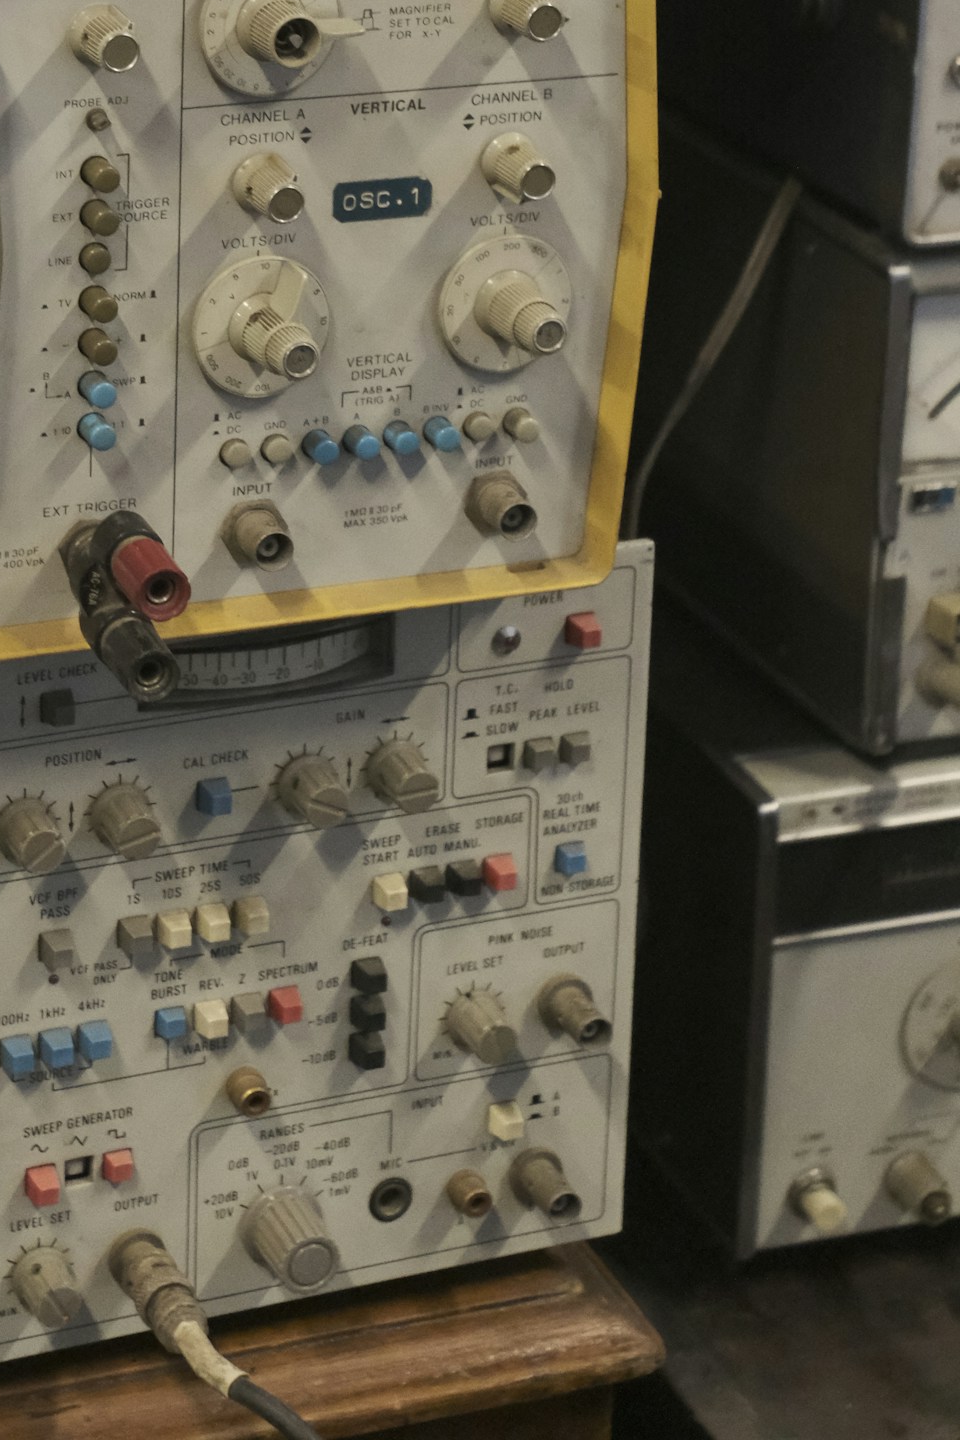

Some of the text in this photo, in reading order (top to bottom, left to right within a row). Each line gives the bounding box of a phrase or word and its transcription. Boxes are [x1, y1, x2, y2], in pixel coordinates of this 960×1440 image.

[389, 3, 452, 15] MAGNIFIER
[433, 15, 455, 26] CAL
[64, 98, 102, 109] PROBE
[471, 90, 538, 106] CHANNEL
[350, 99, 427, 115] VERTICAL
[221, 110, 289, 127] CHANNEL
[480, 112, 542, 126] POSITION
[229, 131, 295, 146] POSITION
[116, 197, 170, 211] TRIGGER
[470, 212, 540, 227] VOLTS/DIV
[221, 233, 296, 249] VOLTS/DIV
[48, 256, 73, 267] LINE
[346, 352, 413, 368] VERTICAL
[351, 366, 406, 381] DISPLAY
[475, 455, 514, 469] INPUT
[232, 483, 273, 497] INPUT
[43, 498, 137, 518] EXT TRIGGER
[524, 591, 564, 606] POWER
[16, 663, 98, 686] LEVEL CHECK
[544, 679, 574, 692] HOLD
[486, 722, 519, 736] SLOW
[45, 749, 102, 767] POSITION
[183, 750, 249, 769] CAL CHECK
[426, 811, 524, 838] ERASE STORAGE
[543, 818, 598, 837] ANALYZER
[362, 835, 402, 850] SWEEP
[362, 850, 399, 866] START
[154, 861, 229, 883] SWEEP TIME
[29, 888, 79, 907] VCF BPF
[40, 906, 71, 920] PASS
[521, 926, 554, 941] NOISE
[343, 933, 388, 951] DE-FEAT
[210, 943, 243, 958] MODE
[544, 942, 585, 959] OUTPUT
[70, 961, 118, 976] VCF PASS
[258, 962, 318, 981] SPECTRUM
[150, 984, 187, 1000] BURST
[23, 1107, 133, 1138] SWEEP GENERATOR
[260, 1122, 305, 1141] RANGES
[315, 1137, 351, 1151] -40dB
[114, 1193, 159, 1212] OUTPUT
[10, 1216, 43, 1233] LEVEL
